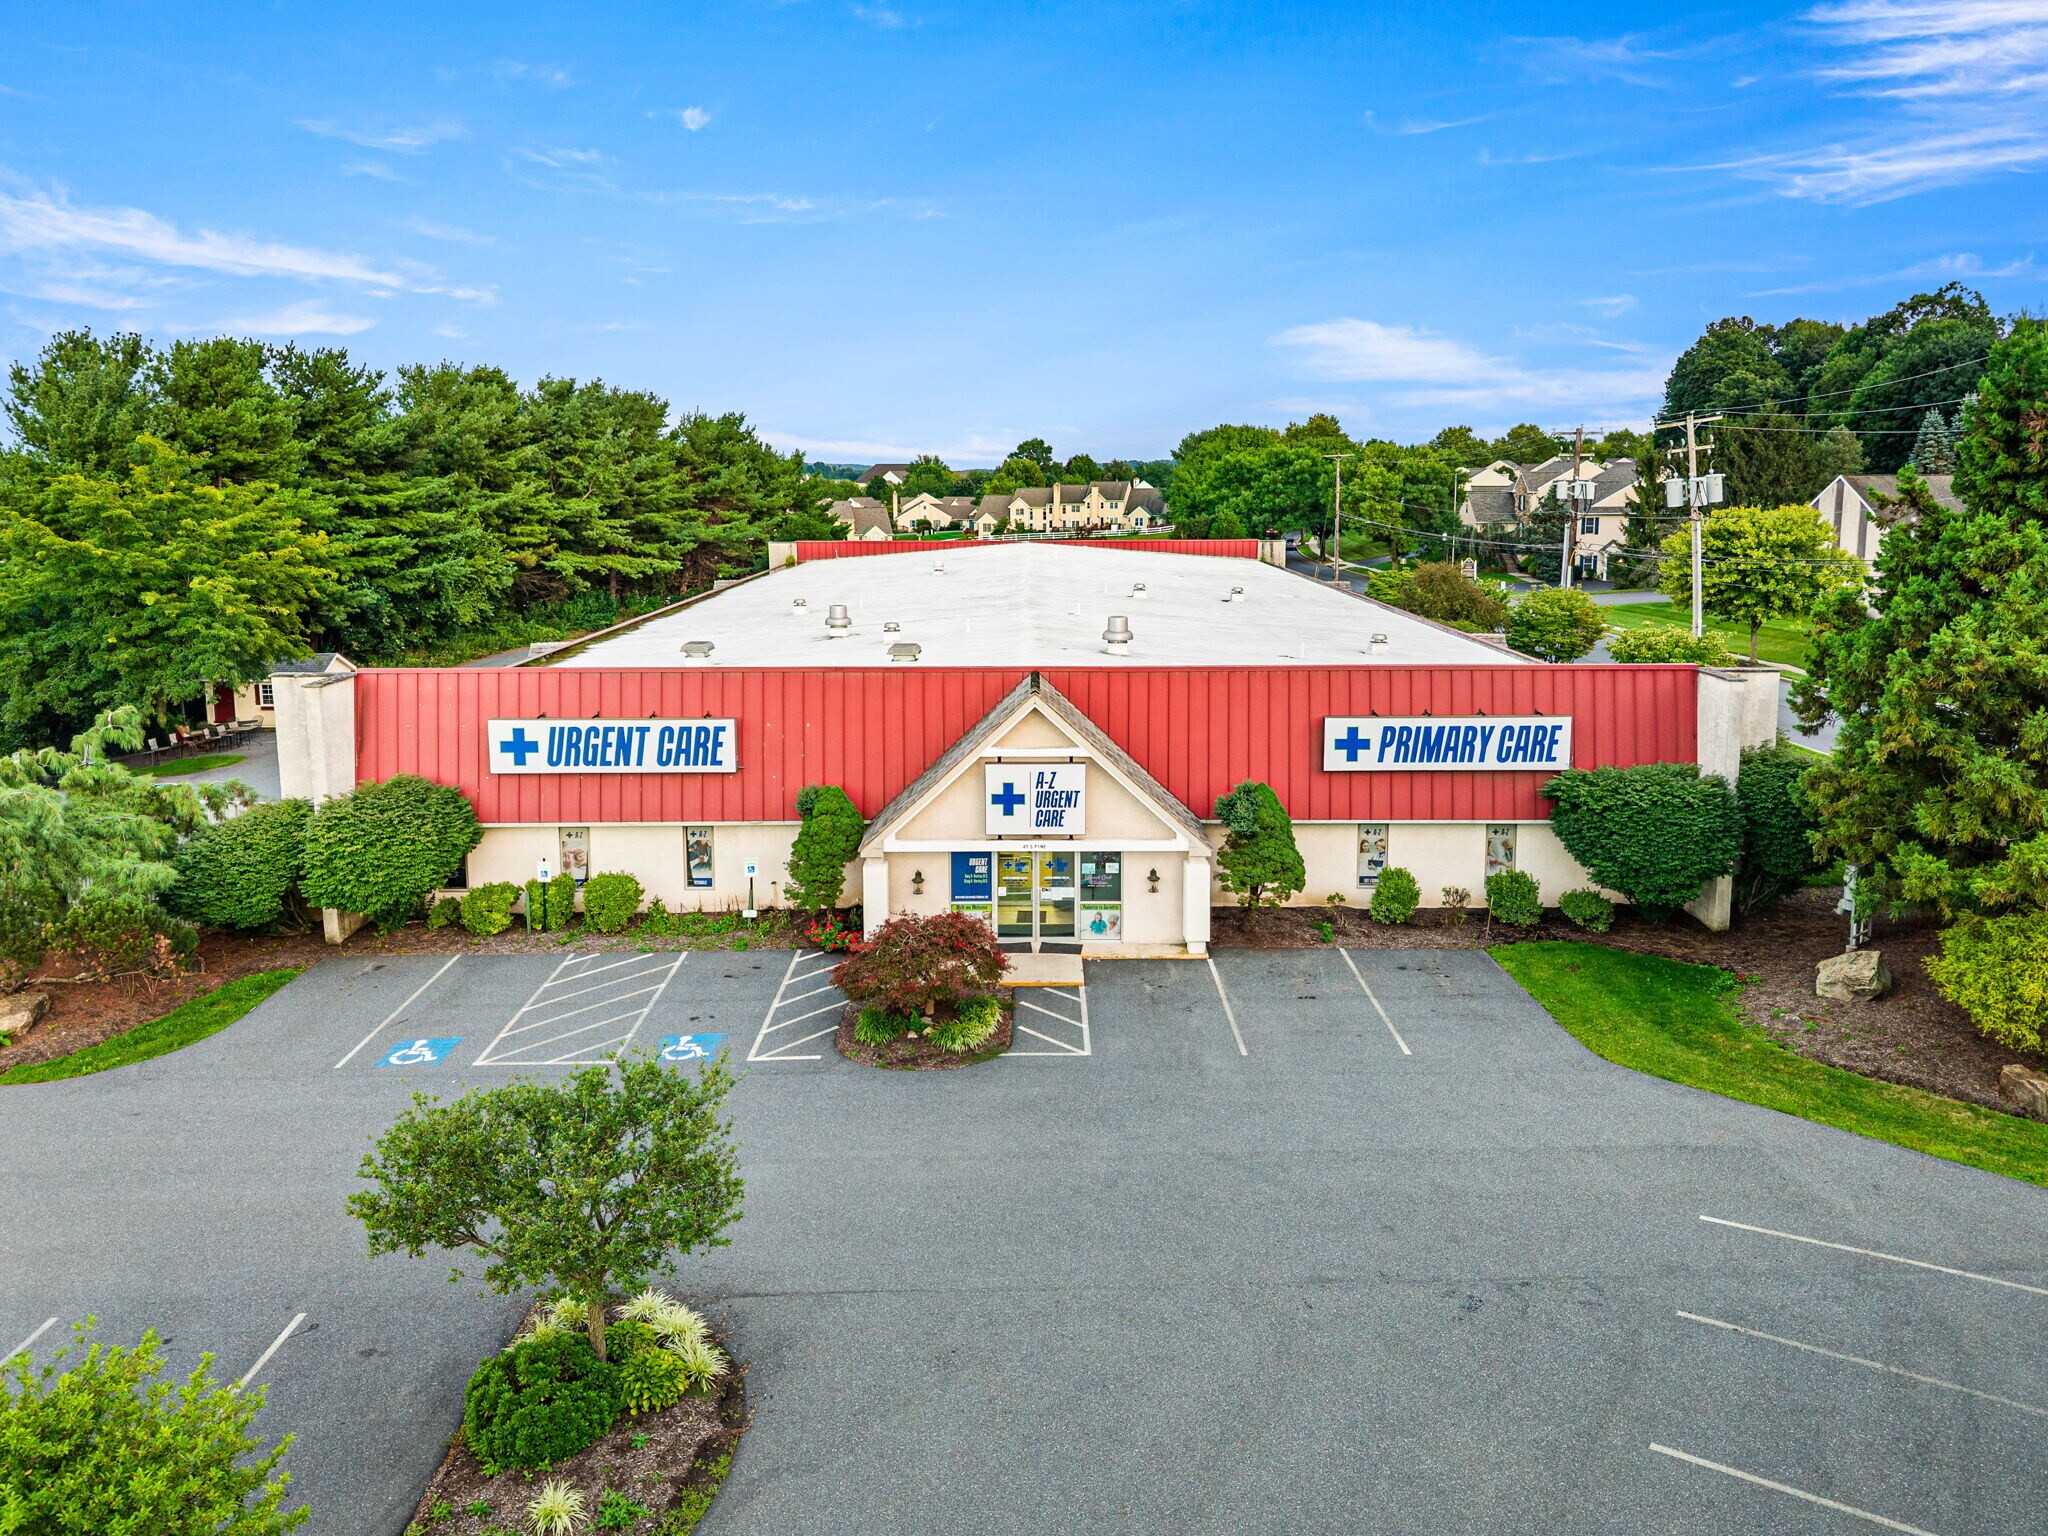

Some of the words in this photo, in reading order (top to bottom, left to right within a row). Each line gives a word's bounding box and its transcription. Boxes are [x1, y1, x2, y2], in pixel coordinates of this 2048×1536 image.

[547, 726, 650, 767] URGENT
[656, 726, 726, 767] CARE
[1377, 725, 1496, 763] PRIMARY
[1496, 725, 1563, 763] CARE
[1035, 771, 1057, 789] A-Z
[1035, 790, 1081, 808] URGENT
[1035, 809, 1066, 827] CARE
[968, 857, 988, 866] URGENT
